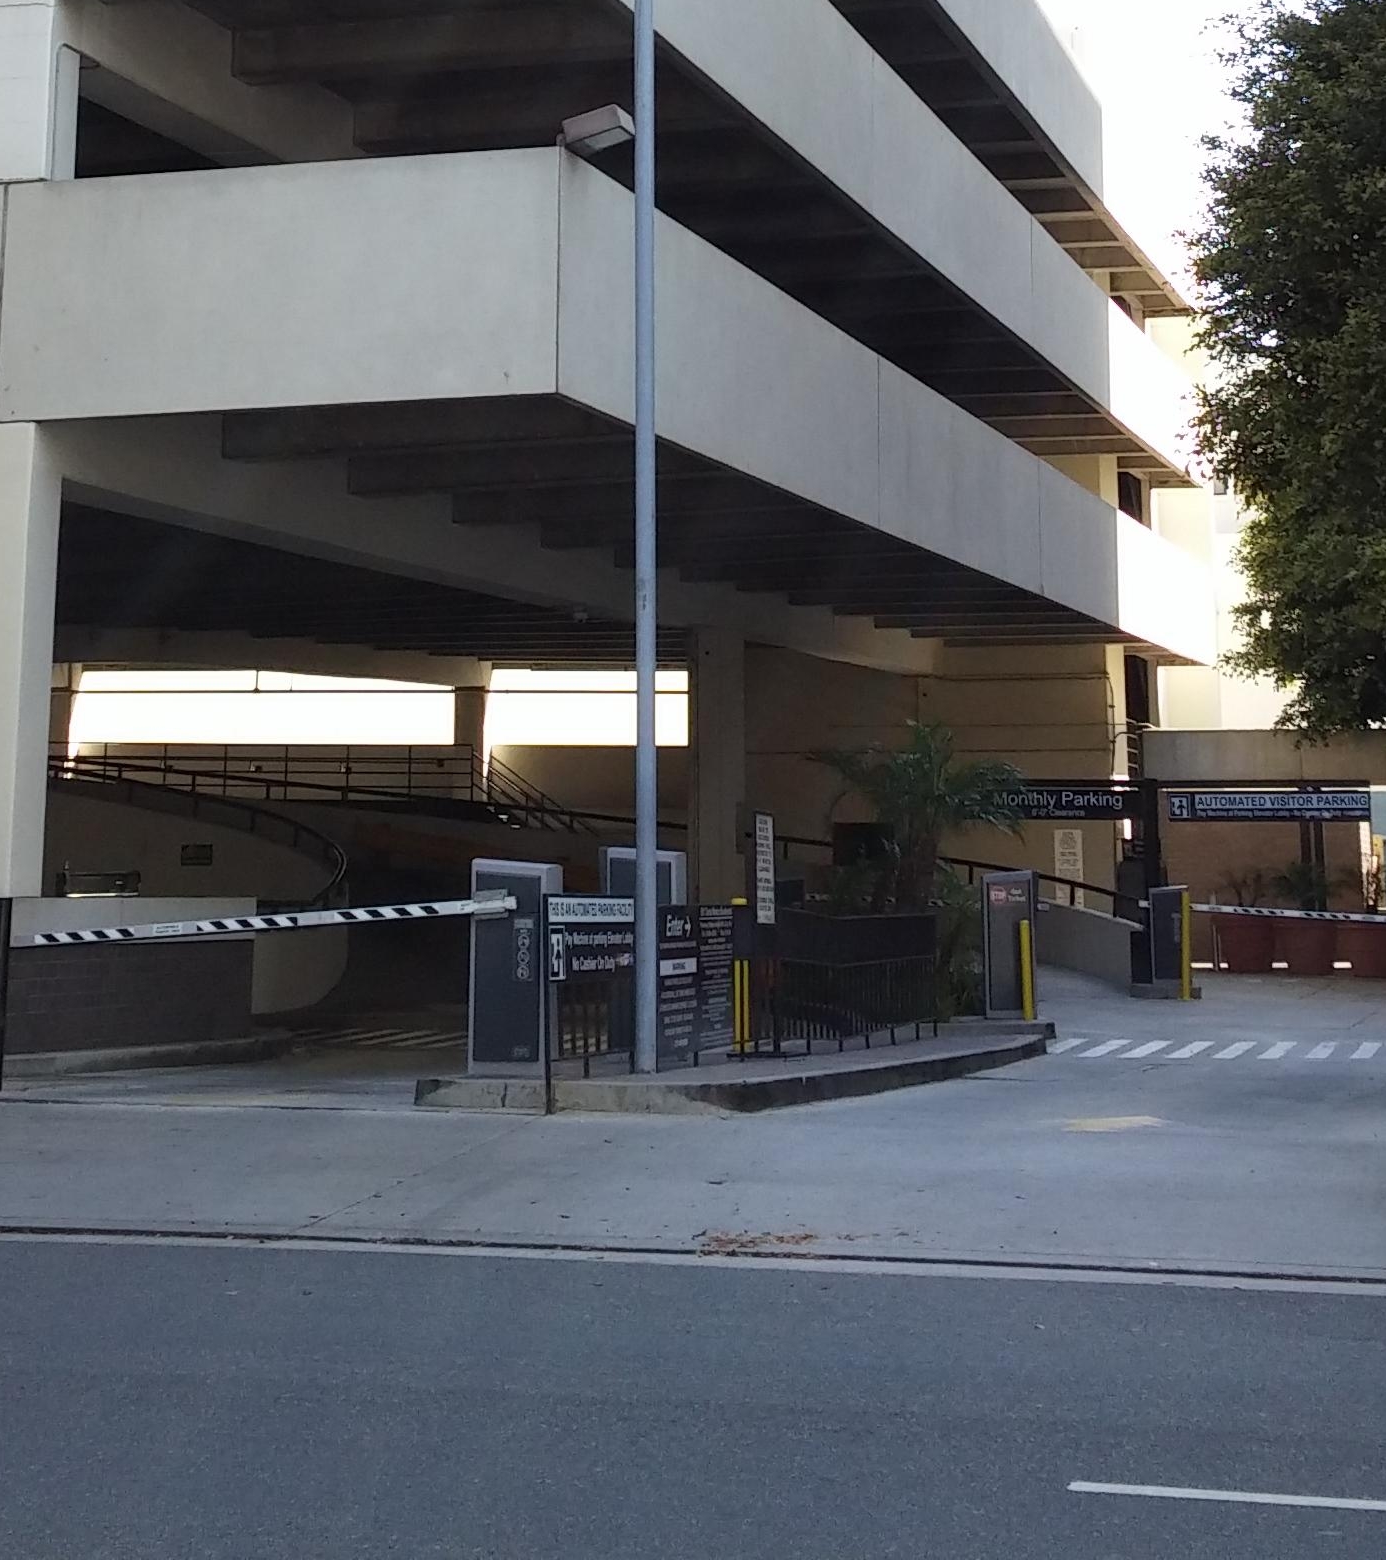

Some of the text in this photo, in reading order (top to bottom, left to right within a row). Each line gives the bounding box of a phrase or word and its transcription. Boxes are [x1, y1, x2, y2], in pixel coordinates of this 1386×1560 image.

[993, 791, 1123, 810] Monthly Parking
[1197, 794, 1367, 807] AUTOMATED VISITOR PARKING
[666, 914, 684, 937] Enter
